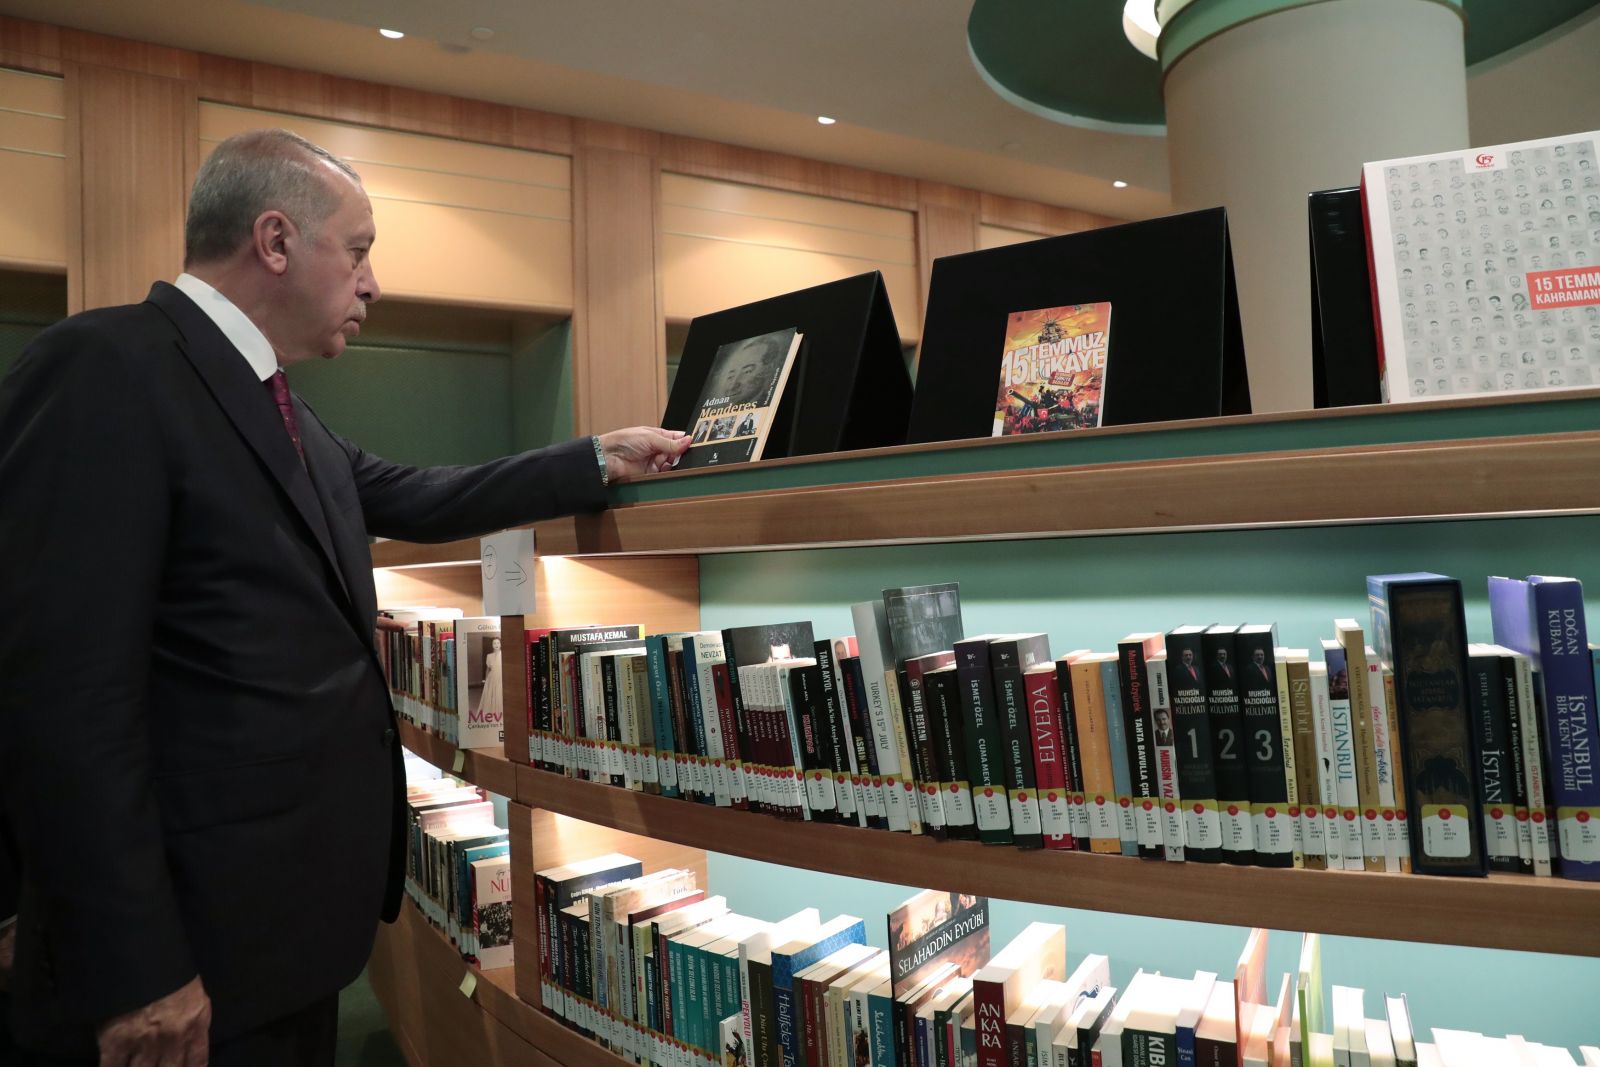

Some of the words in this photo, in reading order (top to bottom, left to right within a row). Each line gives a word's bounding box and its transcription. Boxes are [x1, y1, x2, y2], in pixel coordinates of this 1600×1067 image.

[1535, 277, 1552, 291] 15
[1555, 272, 1600, 289] TEMM
[1029, 332, 1104, 360] TEMMUZ
[1001, 347, 1028, 387] 15
[700, 400, 757, 419] Menderes
[703, 396, 730, 408] Adnan
[571, 633, 603, 643] MUSTAFA
[604, 631, 628, 641] KEMAL
[1548, 609, 1564, 656] KUBAN
[1563, 608, 1579, 655] DOĞAN
[653, 649, 661, 678] Turgut
[701, 651, 722, 659] NEVZAT
[819, 651, 829, 669] TAHA
[1128, 649, 1137, 681] Mustafa
[822, 670, 832, 692] AKYOL
[970, 680, 980, 707] İSMET
[1004, 680, 1015, 707] İSMET
[1178, 688, 1199, 696] MUHSİN
[1212, 688, 1233, 696] MUHSİN
[1248, 688, 1270, 697] MUHSİN
[1479, 672, 1490, 697] ŞEHİR
[1505, 677, 1514, 695] JOHN
[827, 697, 836, 723] Türk'ün
[1130, 682, 1141, 713] Özyürek
[1174, 696, 1205, 704] YAZICIOĞLU
[1175, 705, 1205, 715] KÜLLİYATI
[1210, 705, 1239, 714] KÜLLİYATI
[1244, 696, 1276, 705] YAZICIOĞLU
[1508, 696, 1517, 720] FREELY
[1556, 696, 1568, 714] BİR
[870, 681, 883, 716] TURKEY'S
[878, 733, 889, 750] JULY
[974, 707, 983, 729] ÖZEL
[1008, 708, 1017, 729] ÖZEL
[1246, 706, 1276, 716] KÜLLİYATI
[831, 725, 839, 744] Ateşle
[915, 714, 927, 741] DESTANI
[1031, 685, 1056, 764] ELVEDA
[1135, 718, 1144, 743] TAHTA
[1482, 709, 1493, 743] KÜLTÜR
[1558, 718, 1571, 749] KENT
[855, 736, 867, 760] ASRIN
[978, 738, 987, 763] CUMA
[1011, 739, 1021, 765] CUMA
[1187, 728, 1198, 759] 1
[1219, 729, 1236, 759] 2
[1255, 729, 1272, 761] 3
[1331, 706, 1352, 783] İSTANBUL
[1568, 695, 1593, 791] İSTANBUL
[1137, 745, 1148, 781] BAVULLA
[1160, 750, 1172, 780] MUHSİN
[1562, 751, 1577, 791] TARİHİ
[1482, 749, 1504, 804] İSTAN
[1163, 780, 1174, 799] YAZ
[898, 930, 953, 977] SELAHADDİN
[954, 909, 985, 940] EYYÛBİ
[742, 1000, 752, 1037] İPEKYOLU
[776, 994, 793, 1050] Halifeler
[979, 1002, 1000, 1018] AN
[760, 1014, 768, 1034] Dört
[981, 1018, 1000, 1033] KA
[982, 1033, 1001, 1048] RA
